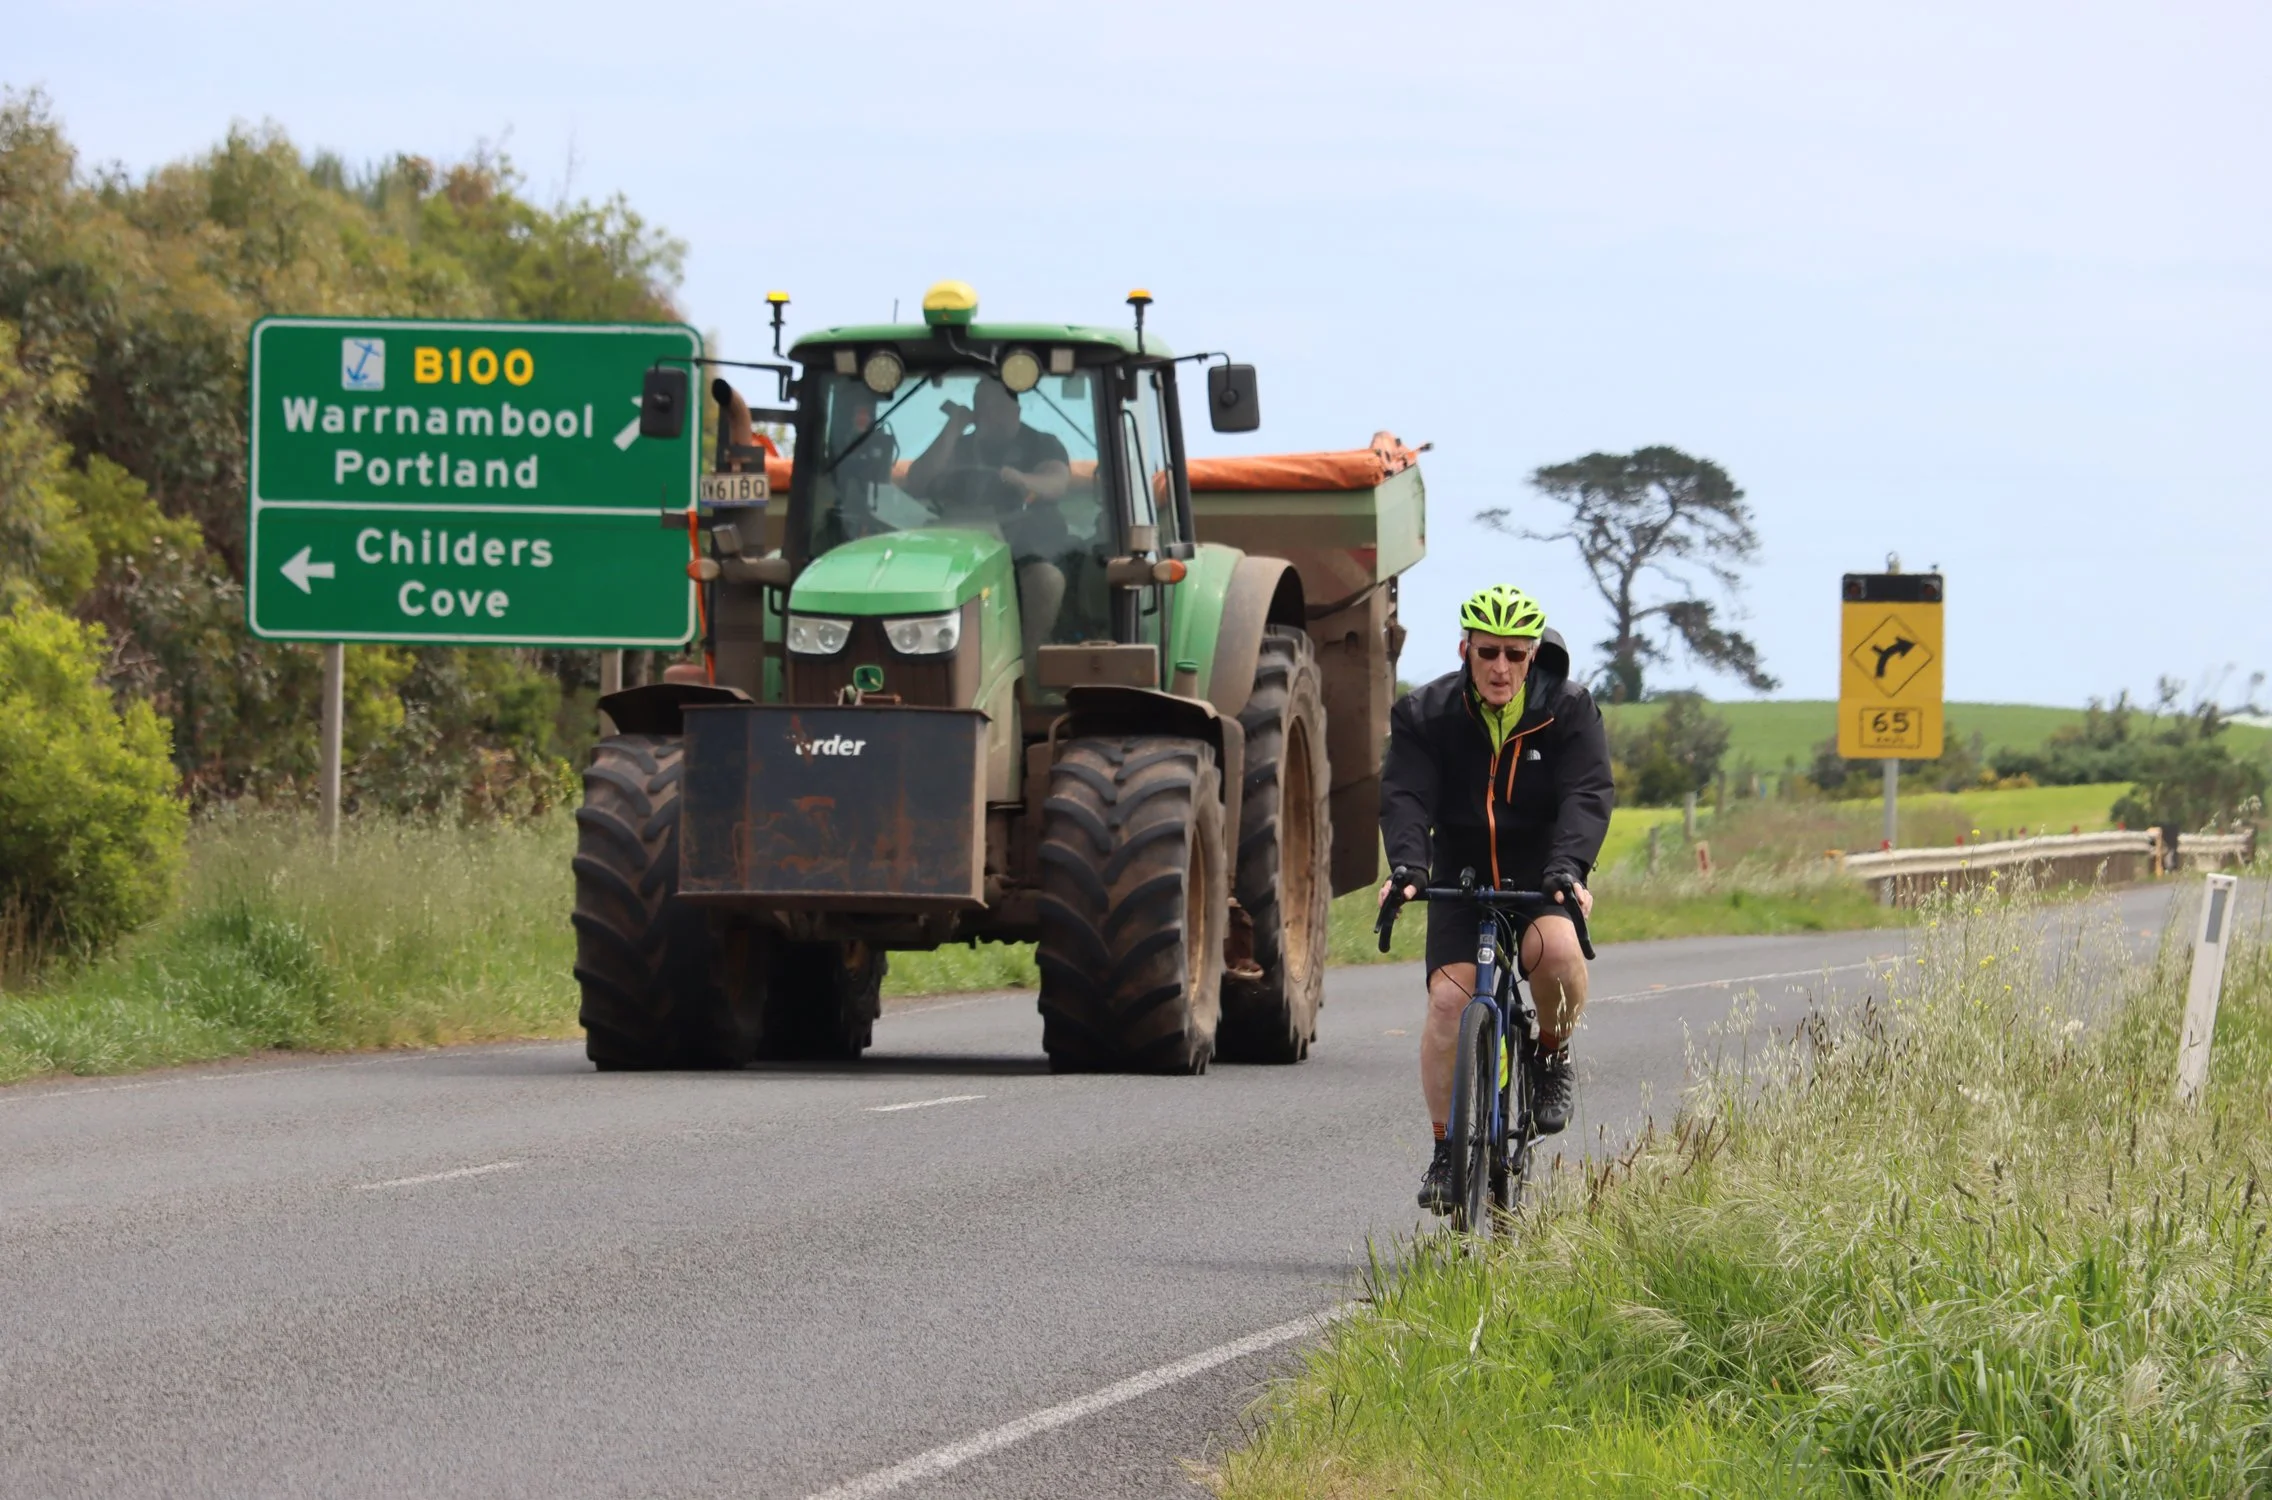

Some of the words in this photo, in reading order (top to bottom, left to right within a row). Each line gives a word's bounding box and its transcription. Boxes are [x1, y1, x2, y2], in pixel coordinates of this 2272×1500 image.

[414, 346, 535, 386] B100
[283, 397, 593, 438] Warrnambool
[335, 449, 538, 488] Portland
[356, 527, 553, 567] Childers
[398, 580, 509, 617] Cove
[1872, 711, 1909, 733] 65
